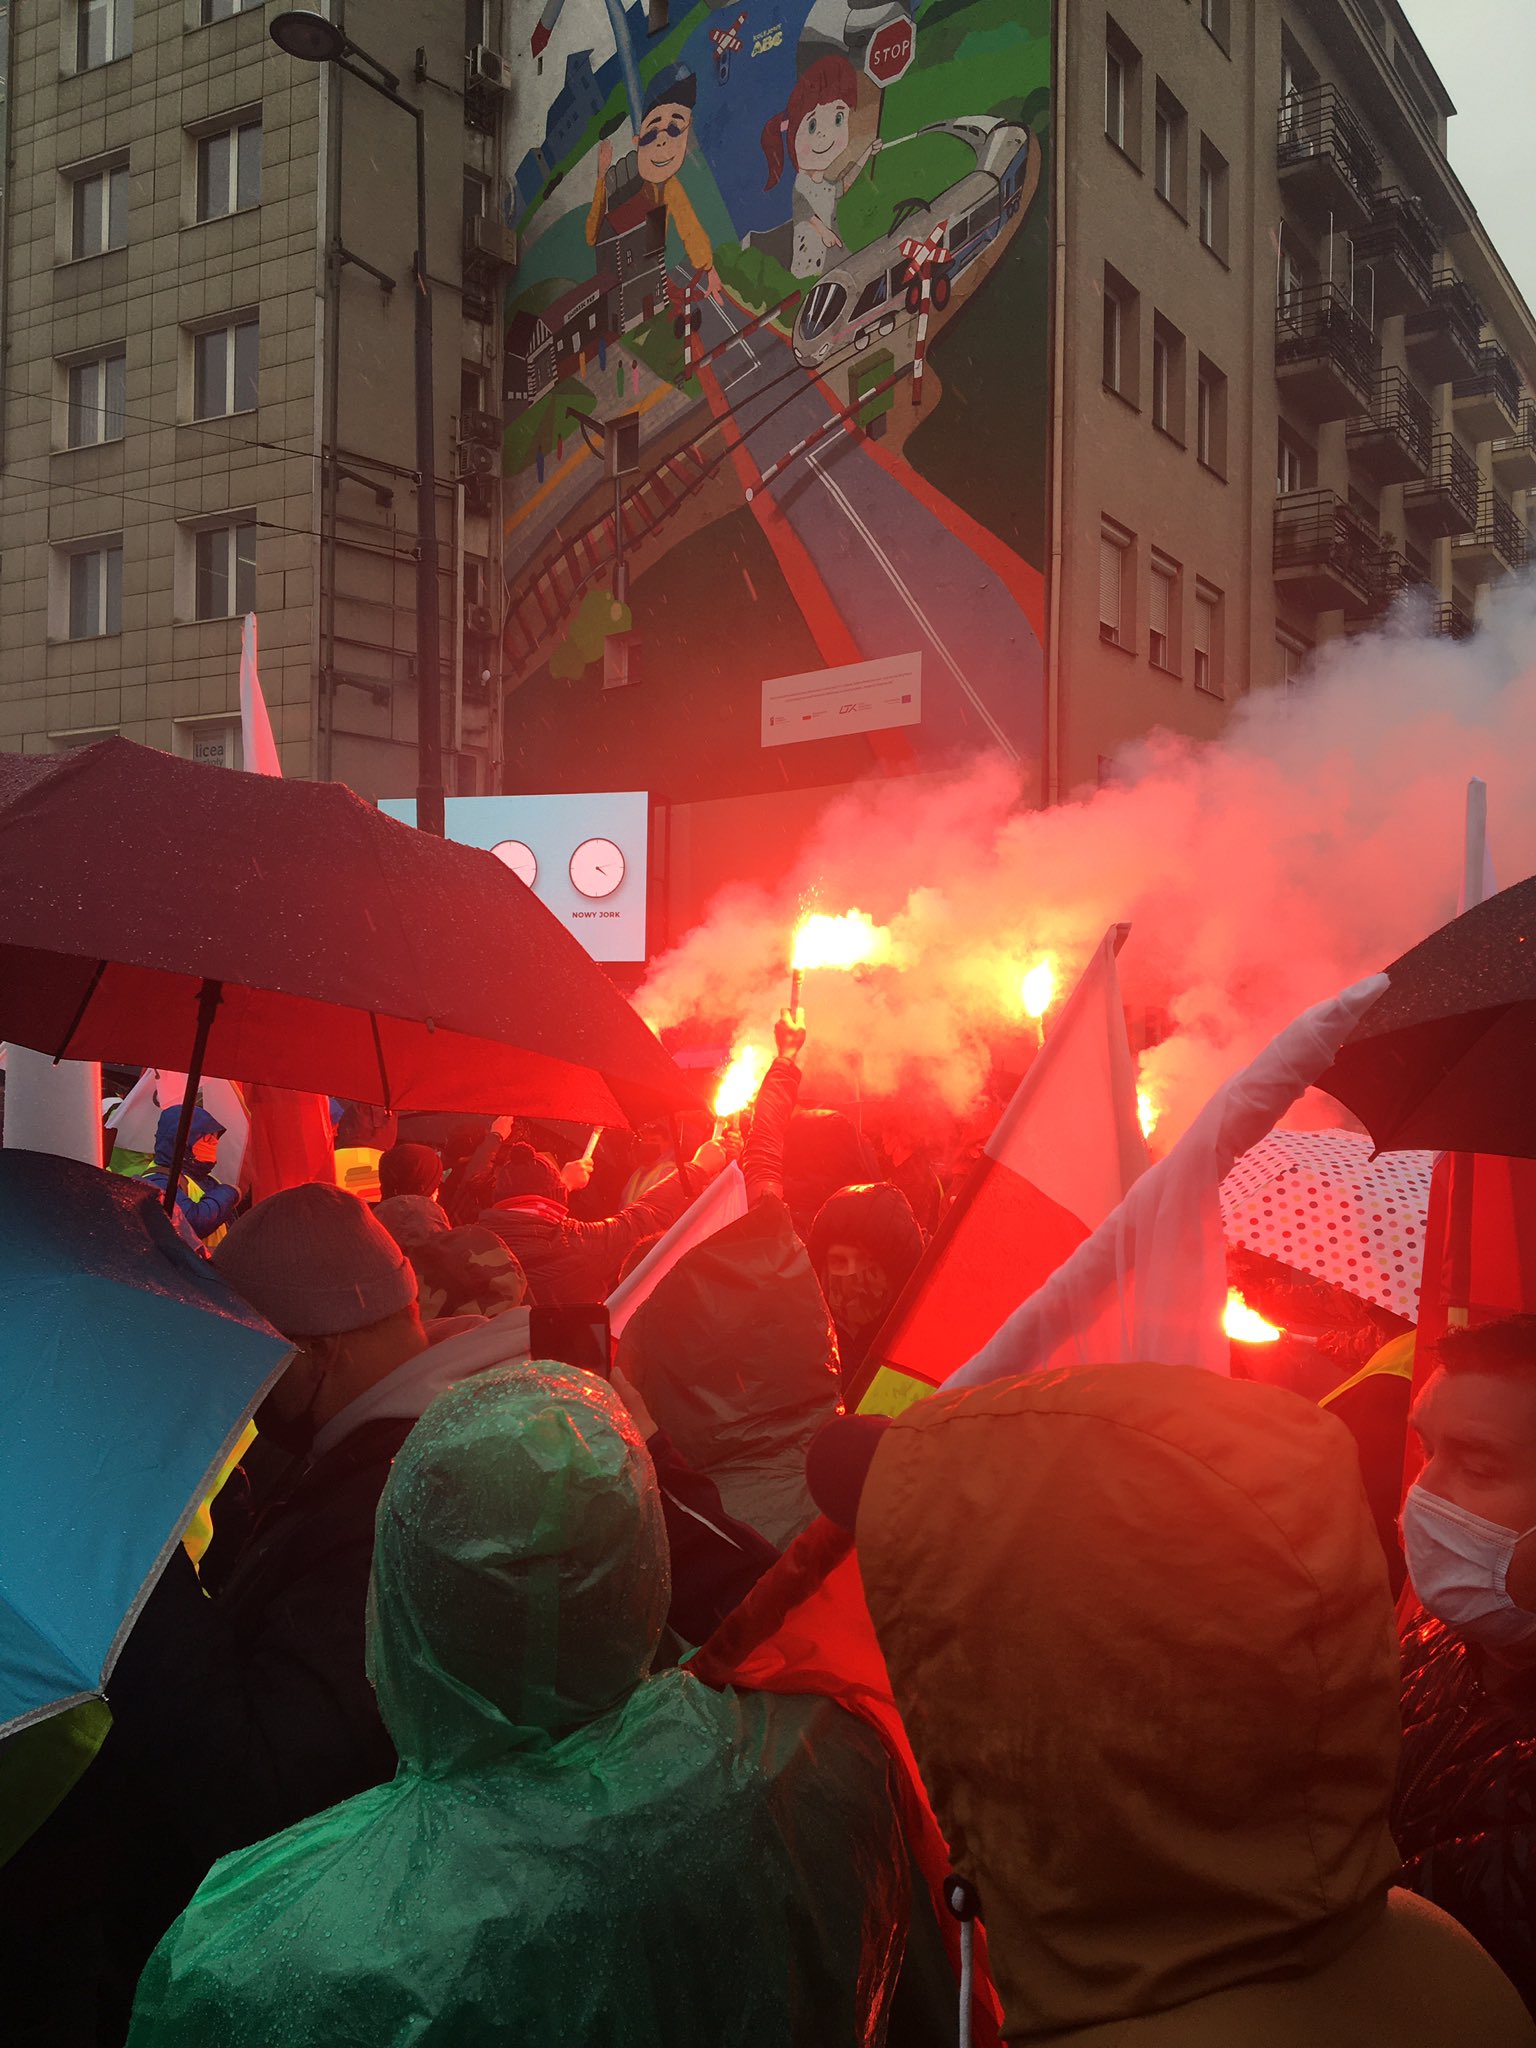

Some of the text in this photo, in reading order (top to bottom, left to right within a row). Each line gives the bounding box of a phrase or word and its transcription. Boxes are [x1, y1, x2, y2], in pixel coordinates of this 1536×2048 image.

[751, 32, 783, 57] ABC
[874, 40, 910, 65] STOP
[195, 743, 224, 757] licea
